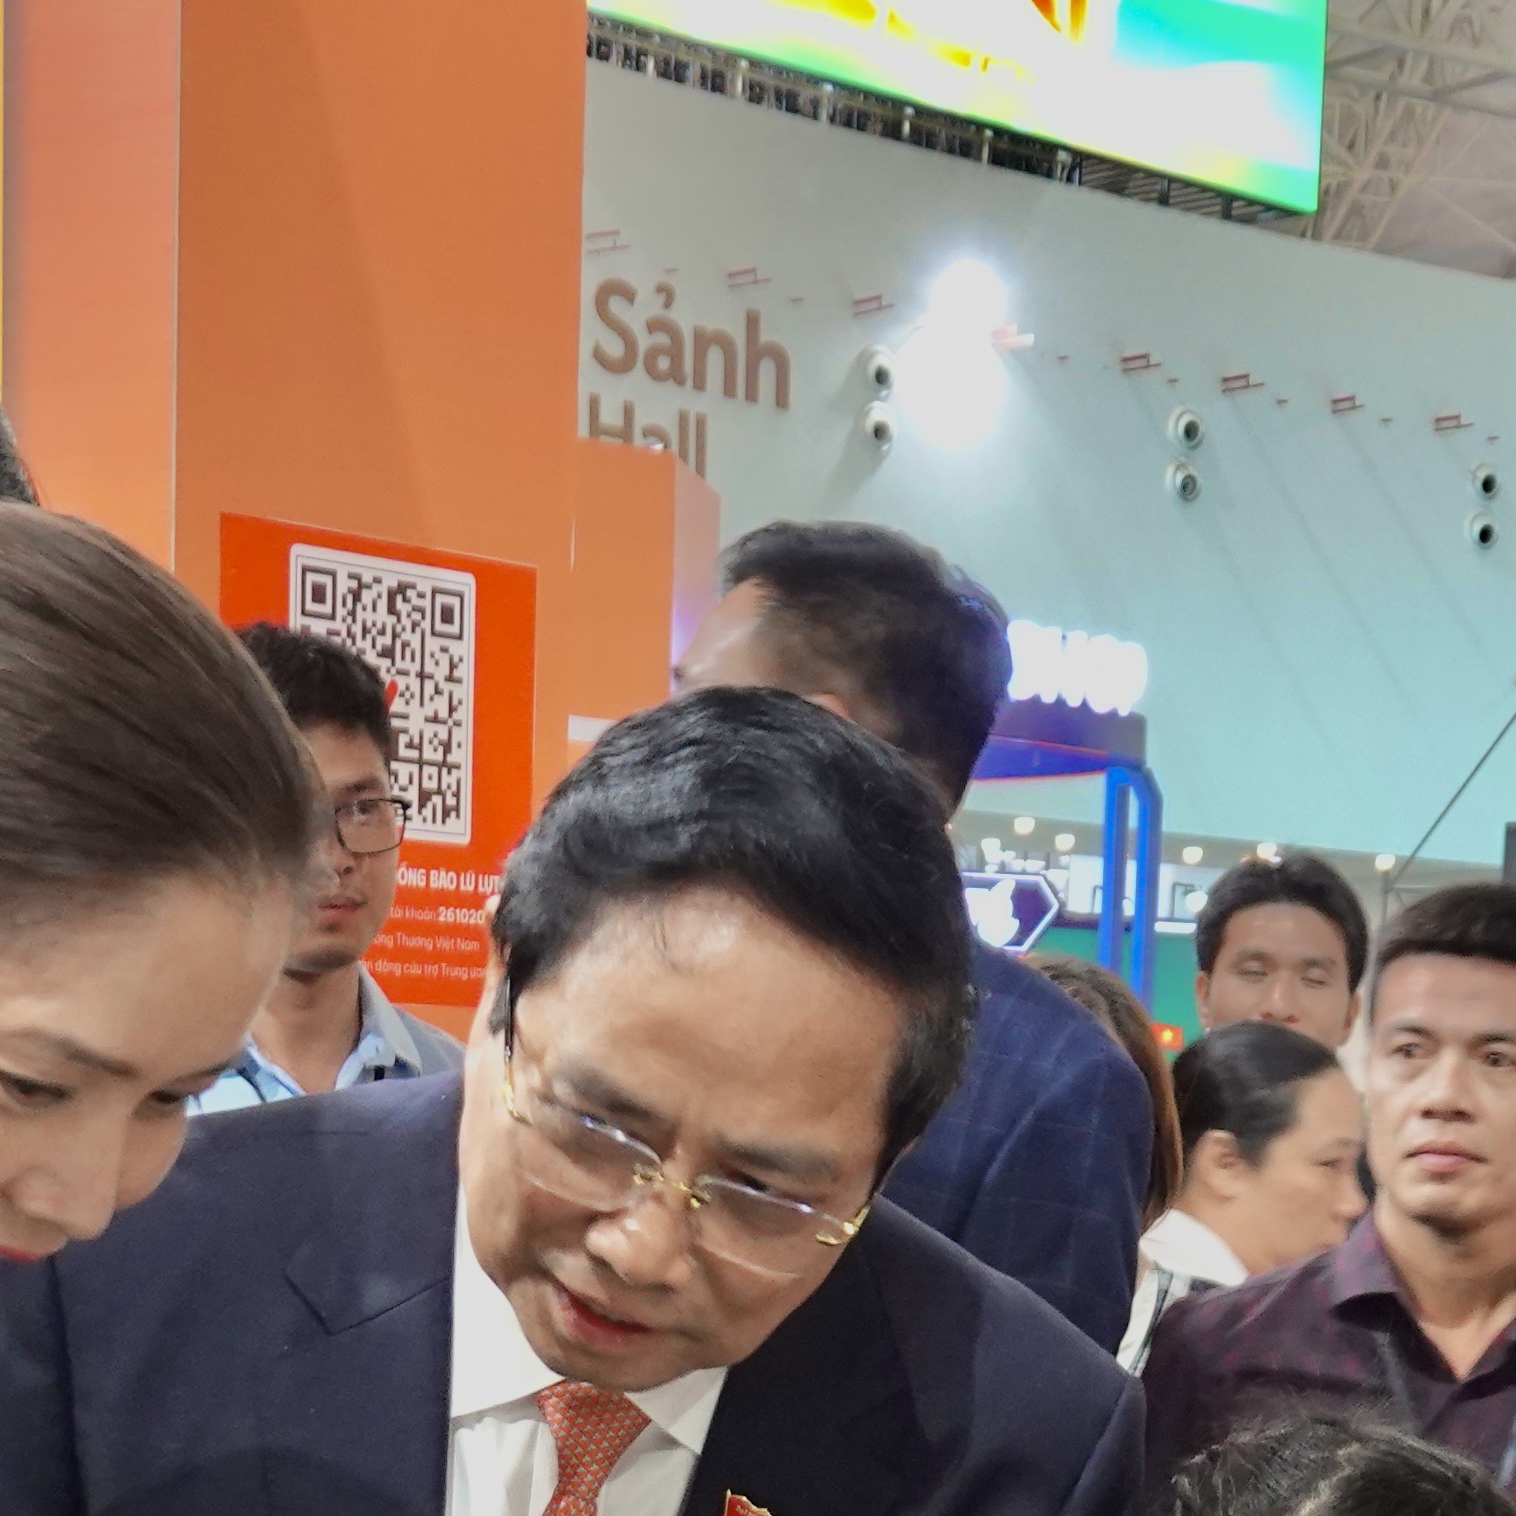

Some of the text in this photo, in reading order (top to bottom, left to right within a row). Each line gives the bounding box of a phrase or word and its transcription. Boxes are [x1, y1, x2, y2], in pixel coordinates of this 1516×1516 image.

[592, 276, 792, 409] Sảnh
[436, 935, 455, 951] Việt
[456, 937, 480, 950] Nam
